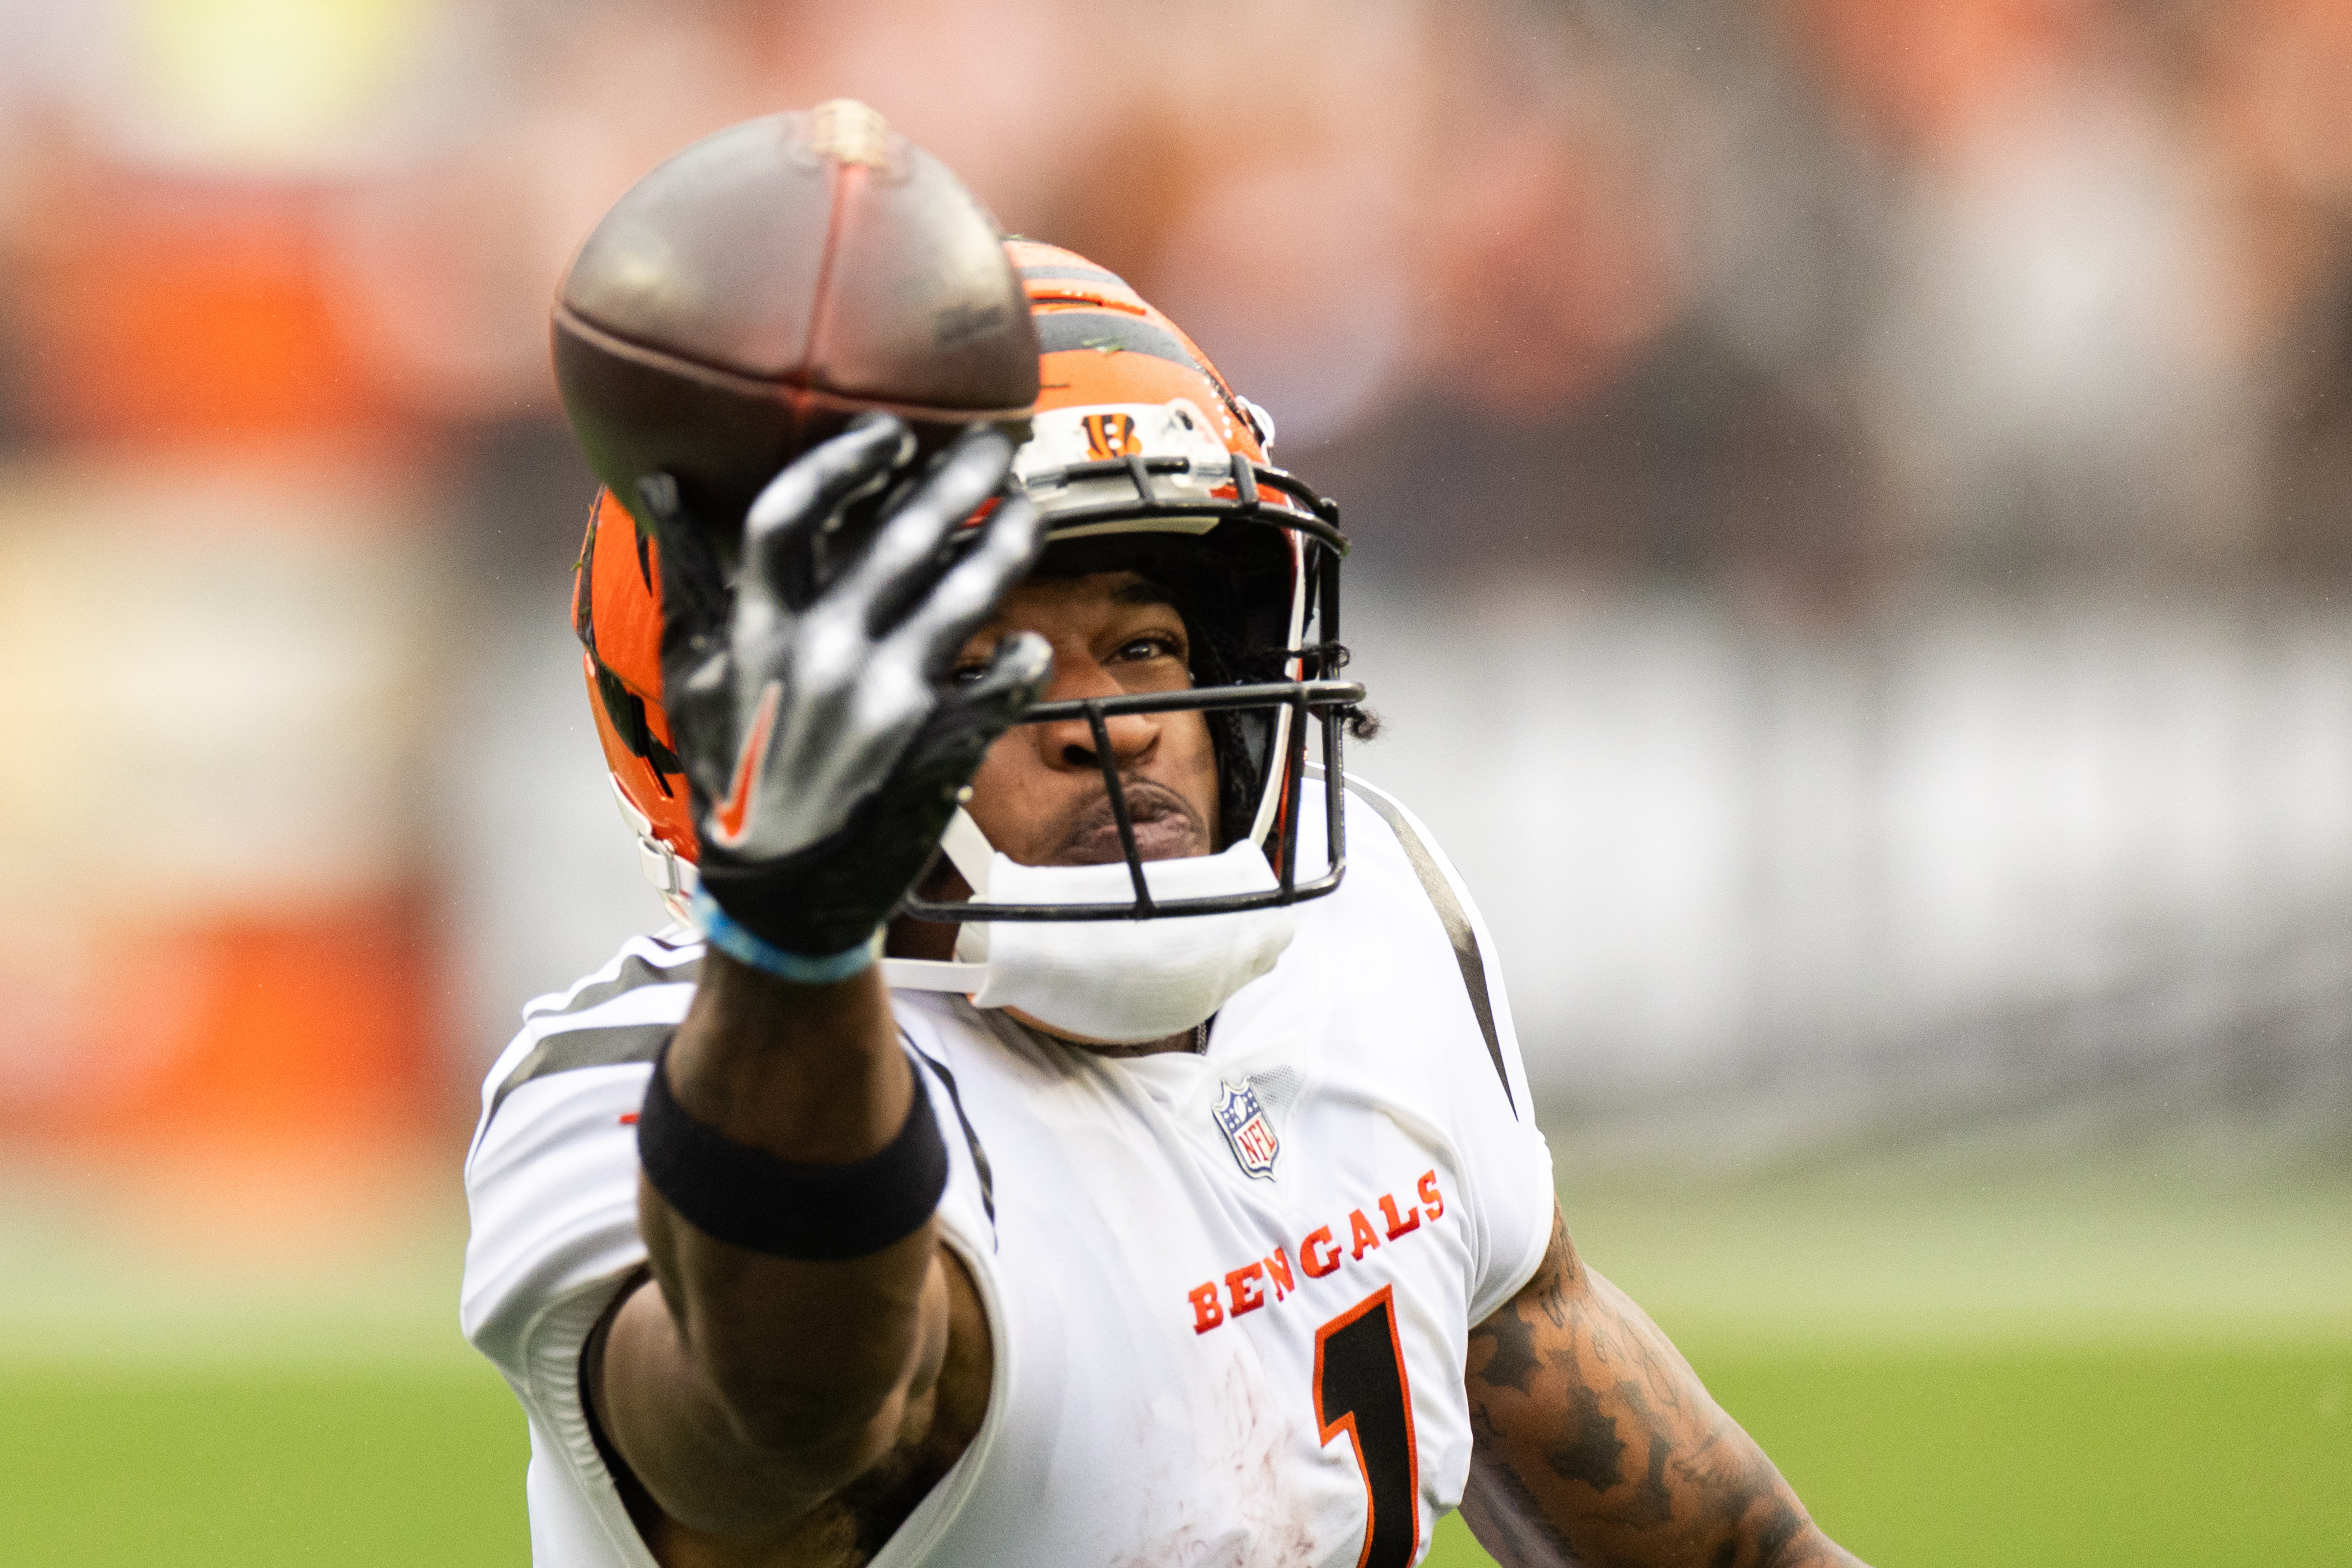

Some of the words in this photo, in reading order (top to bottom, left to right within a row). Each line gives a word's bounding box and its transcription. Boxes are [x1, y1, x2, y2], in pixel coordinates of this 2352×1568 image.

[1238, 1120, 1275, 1164] NFL
[1188, 1170, 1444, 1335] BENGALS
[1313, 1283, 1419, 1568] 1
